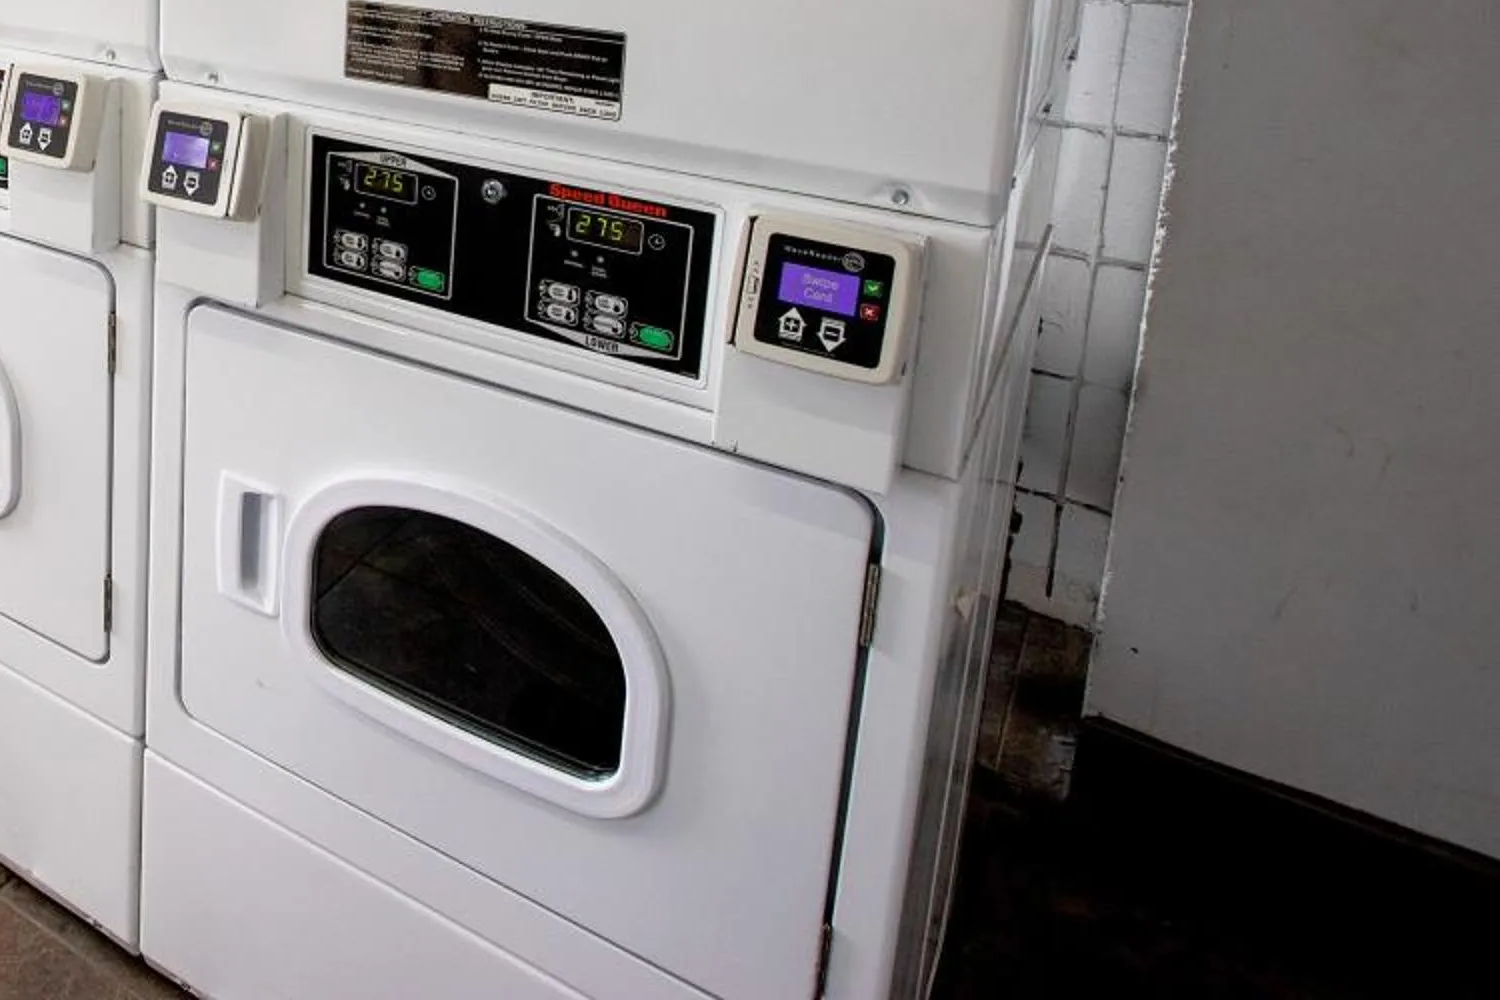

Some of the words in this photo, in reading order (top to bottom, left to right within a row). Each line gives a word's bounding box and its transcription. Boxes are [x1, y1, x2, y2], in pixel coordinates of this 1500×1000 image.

[380, 154, 407, 168] UPPER
[363, 166, 403, 193] 275
[548, 183, 605, 206] Speed
[607, 194, 668, 218] Queen
[575, 213, 624, 242] 275
[585, 335, 619, 353] LOWER
